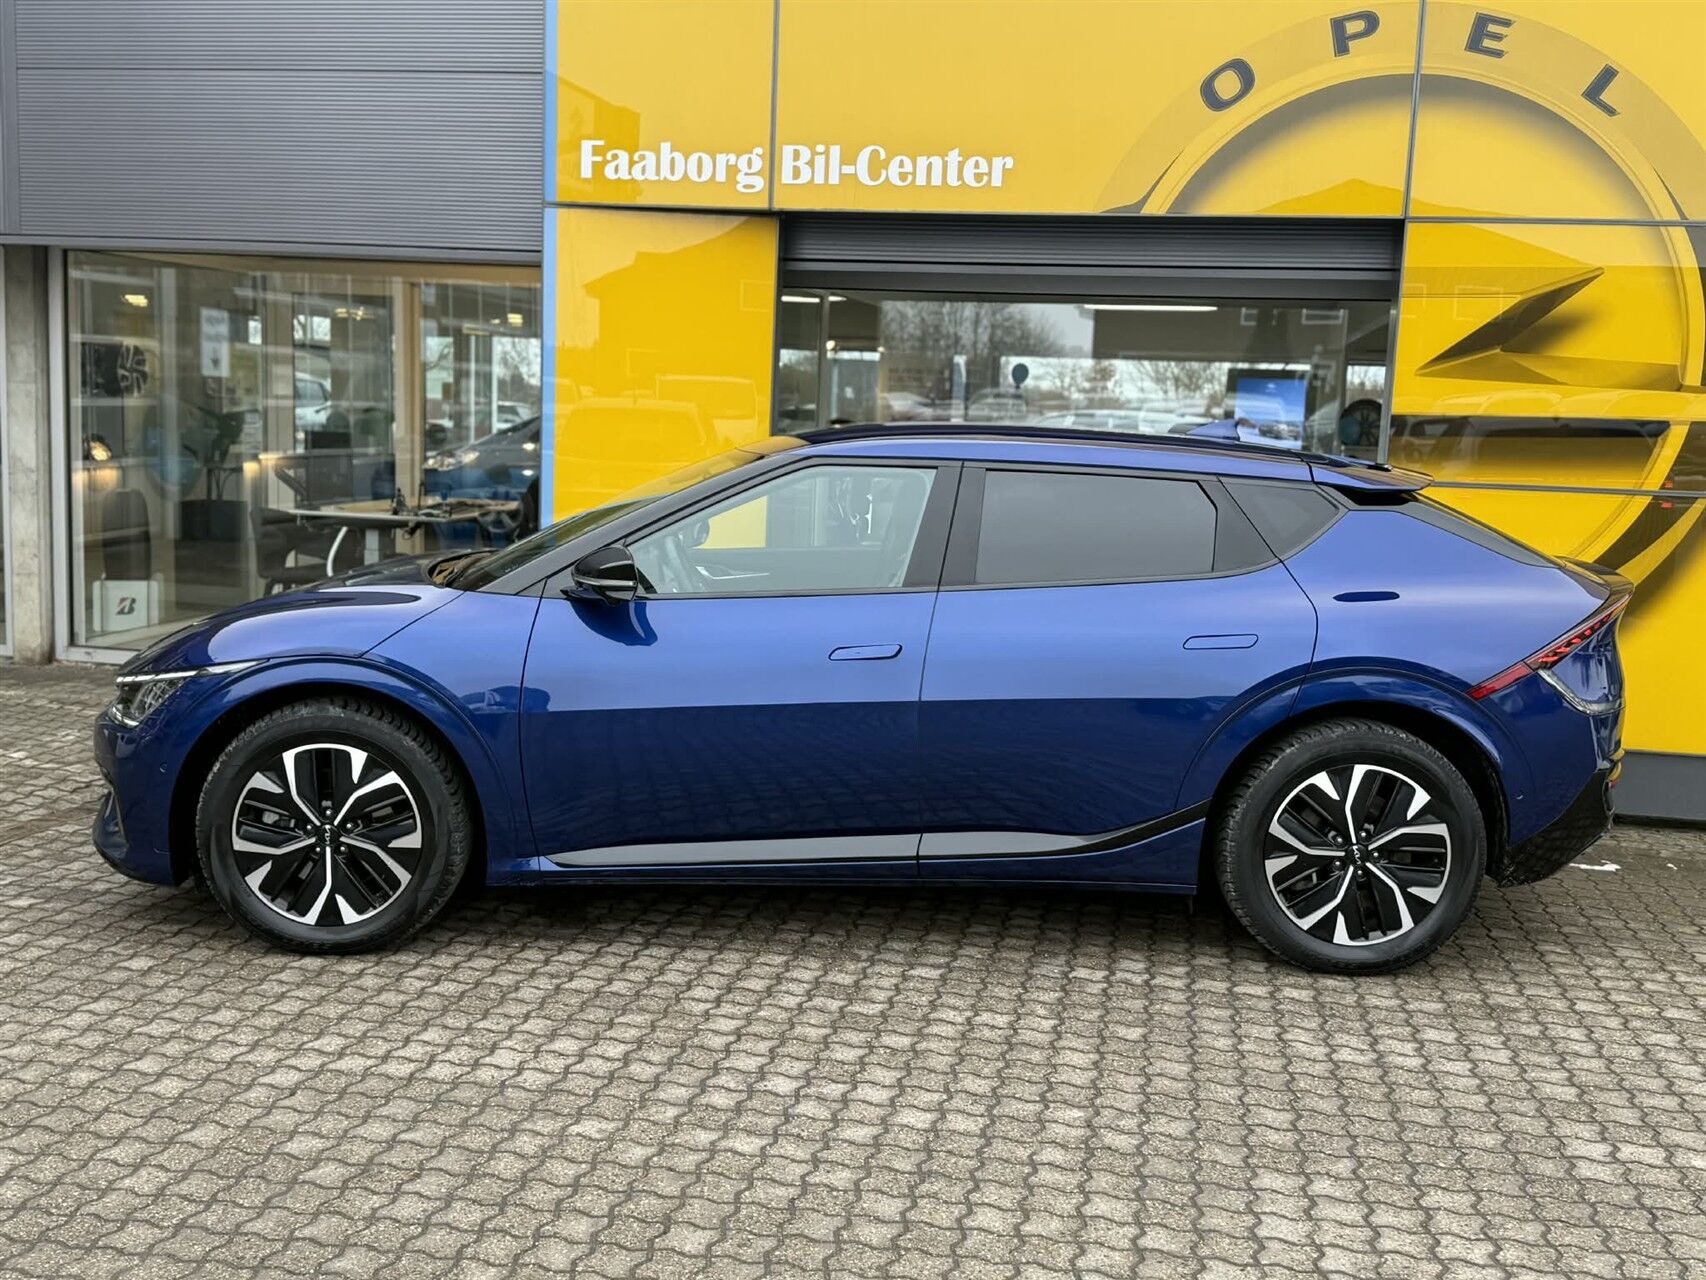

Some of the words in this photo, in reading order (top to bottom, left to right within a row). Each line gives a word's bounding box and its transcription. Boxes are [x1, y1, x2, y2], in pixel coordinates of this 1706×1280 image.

[1199, 10, 1621, 117] OPEL
[580, 139, 765, 193] Faaborg
[780, 143, 1014, 187] Bil-Center
